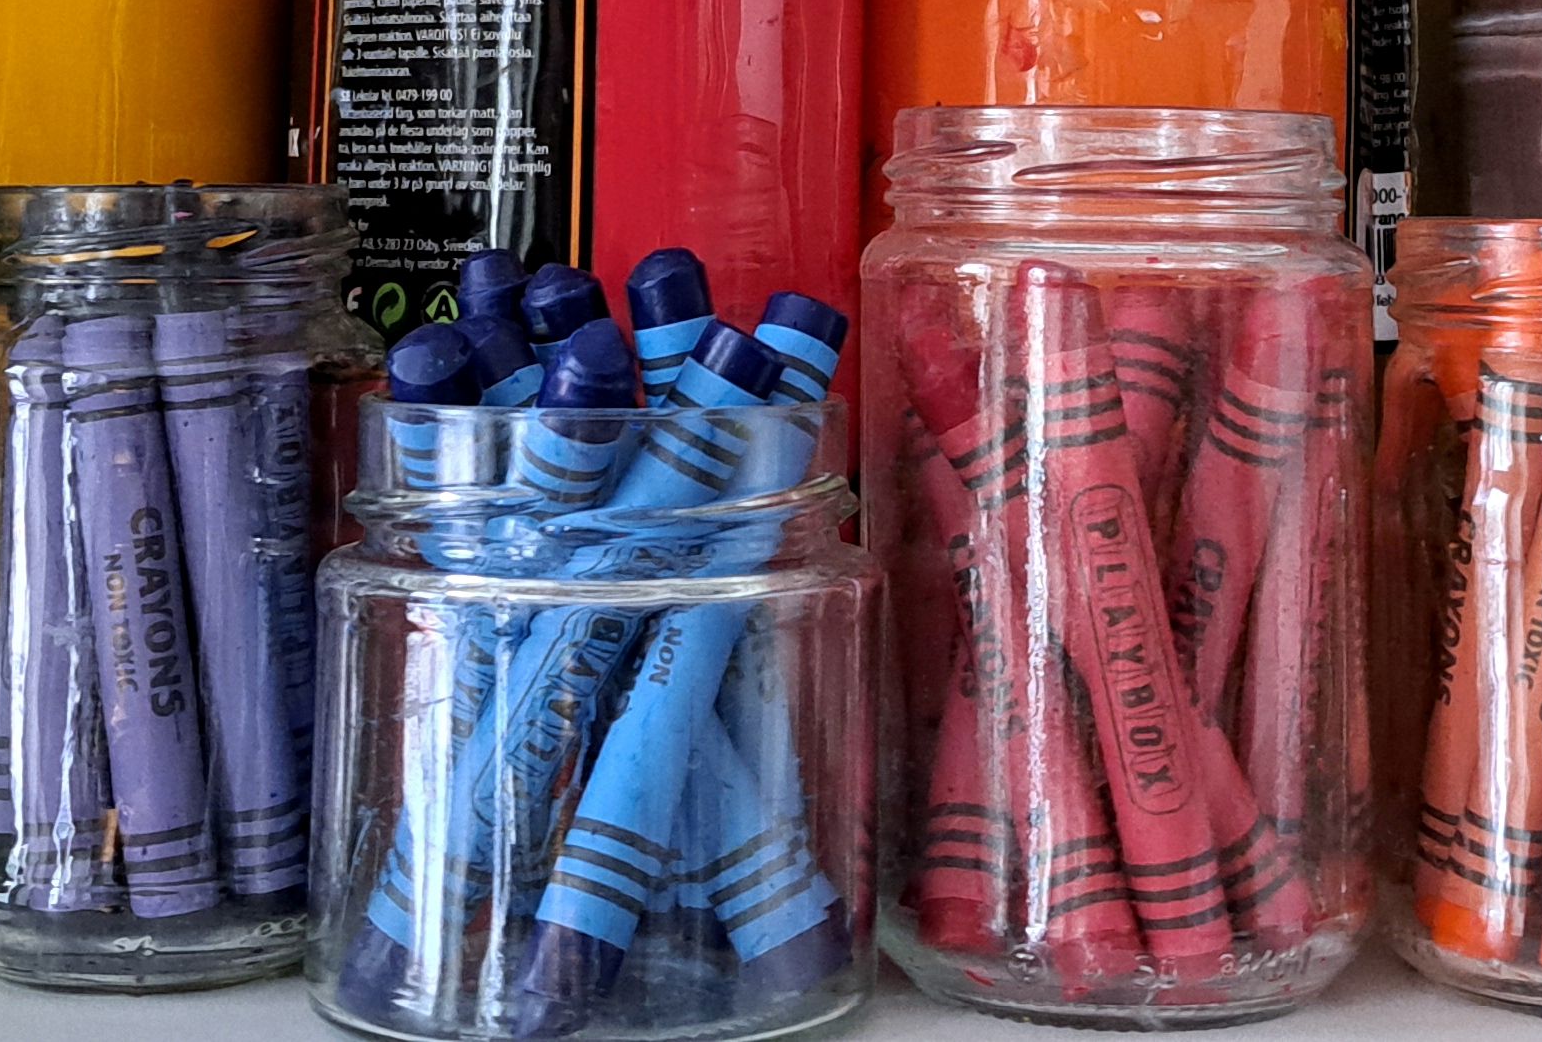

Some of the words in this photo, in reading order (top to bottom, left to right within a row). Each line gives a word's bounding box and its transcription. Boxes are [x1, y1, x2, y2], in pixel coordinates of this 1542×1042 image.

[396, 89, 438, 101] 0479-199
[440, 89, 452, 101] 00
[472, 127, 493, 137] som
[526, 143, 549, 154] Kan
[443, 239, 483, 252] Sweden
[103, 553, 127, 612] NON
[130, 507, 186, 717] CRAYONS
[111, 618, 139, 693] TOXIC
[649, 626, 683, 687] NON
[1087, 518, 1175, 792] PLAYBOX
